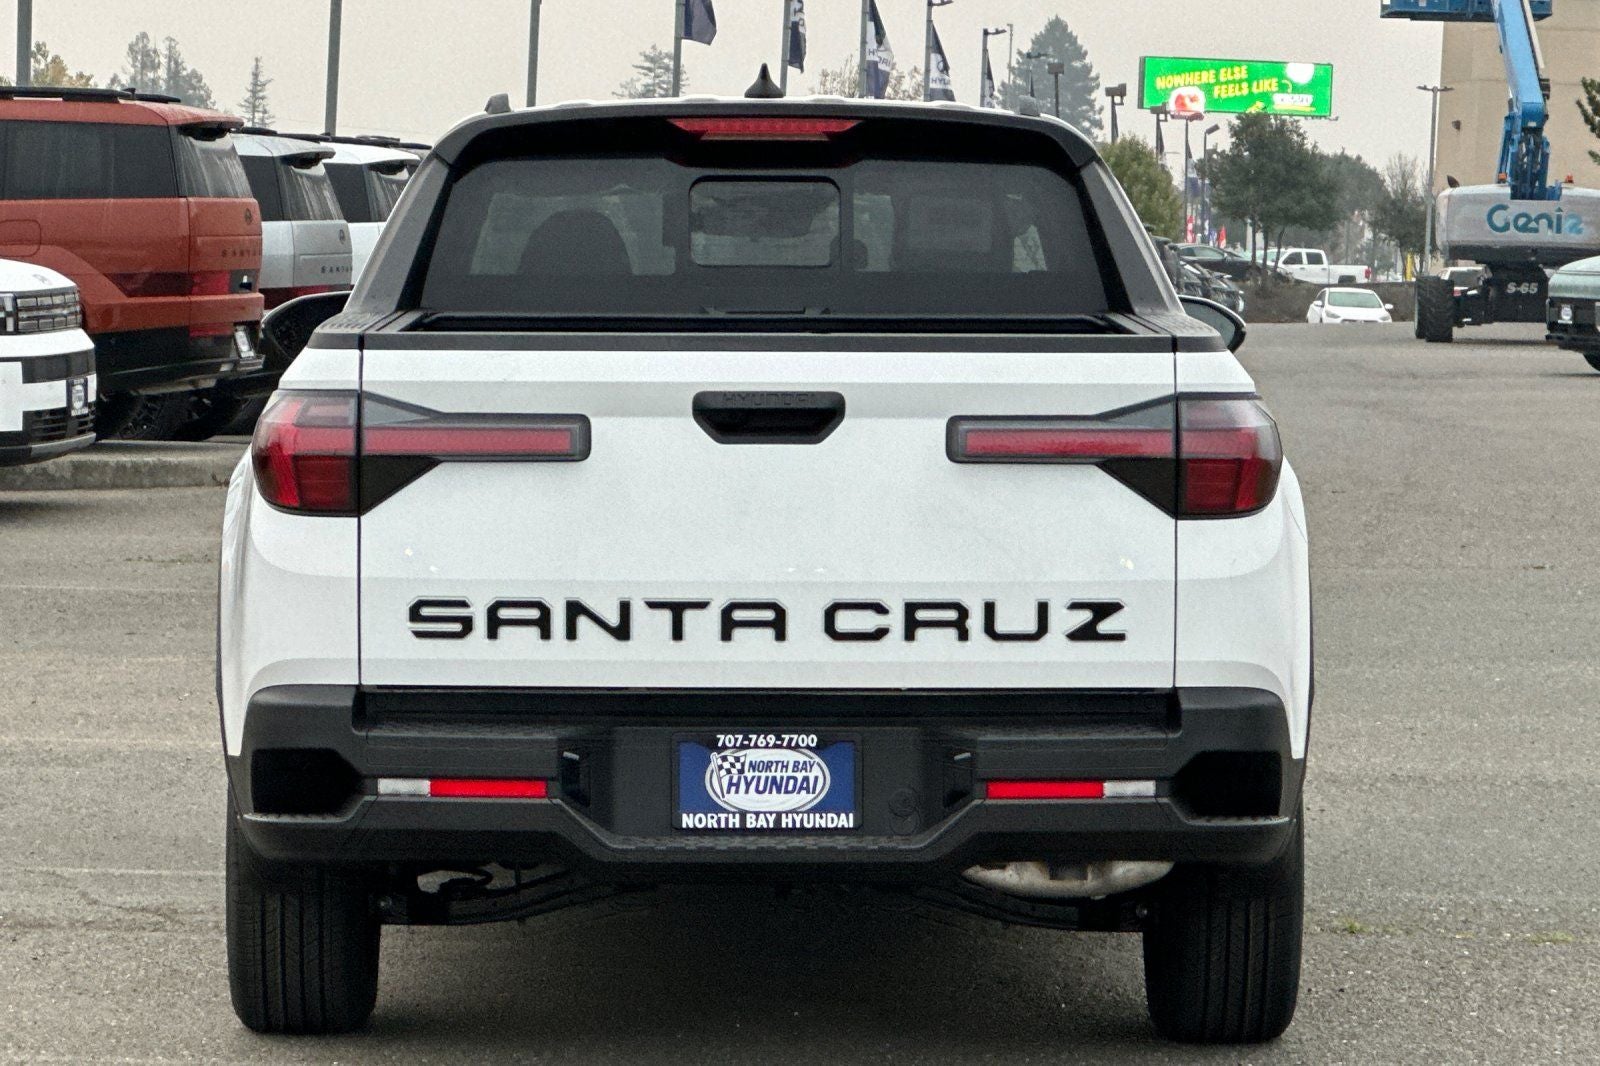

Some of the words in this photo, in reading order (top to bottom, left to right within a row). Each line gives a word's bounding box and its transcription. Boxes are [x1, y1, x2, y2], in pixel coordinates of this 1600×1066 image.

[1156, 69, 1216, 90] NOWHERE
[1219, 65, 1248, 81] ELSE
[1213, 82, 1249, 99] FEELS
[1252, 77, 1279, 94] LIKE
[1486, 203, 1584, 235] Genie
[1506, 281, 1539, 294] S-65
[407, 596, 788, 642] SANTA
[823, 597, 1128, 642] CRUZ
[716, 734, 818, 748] 707-769-7700
[747, 760, 789, 773] NORTH
[791, 760, 817, 773] BAY
[725, 775, 819, 795] HYUNDAI
[681, 813, 740, 829] NORTH
[746, 813, 776, 829] BAY
[782, 812, 854, 829] HYUNDAI
